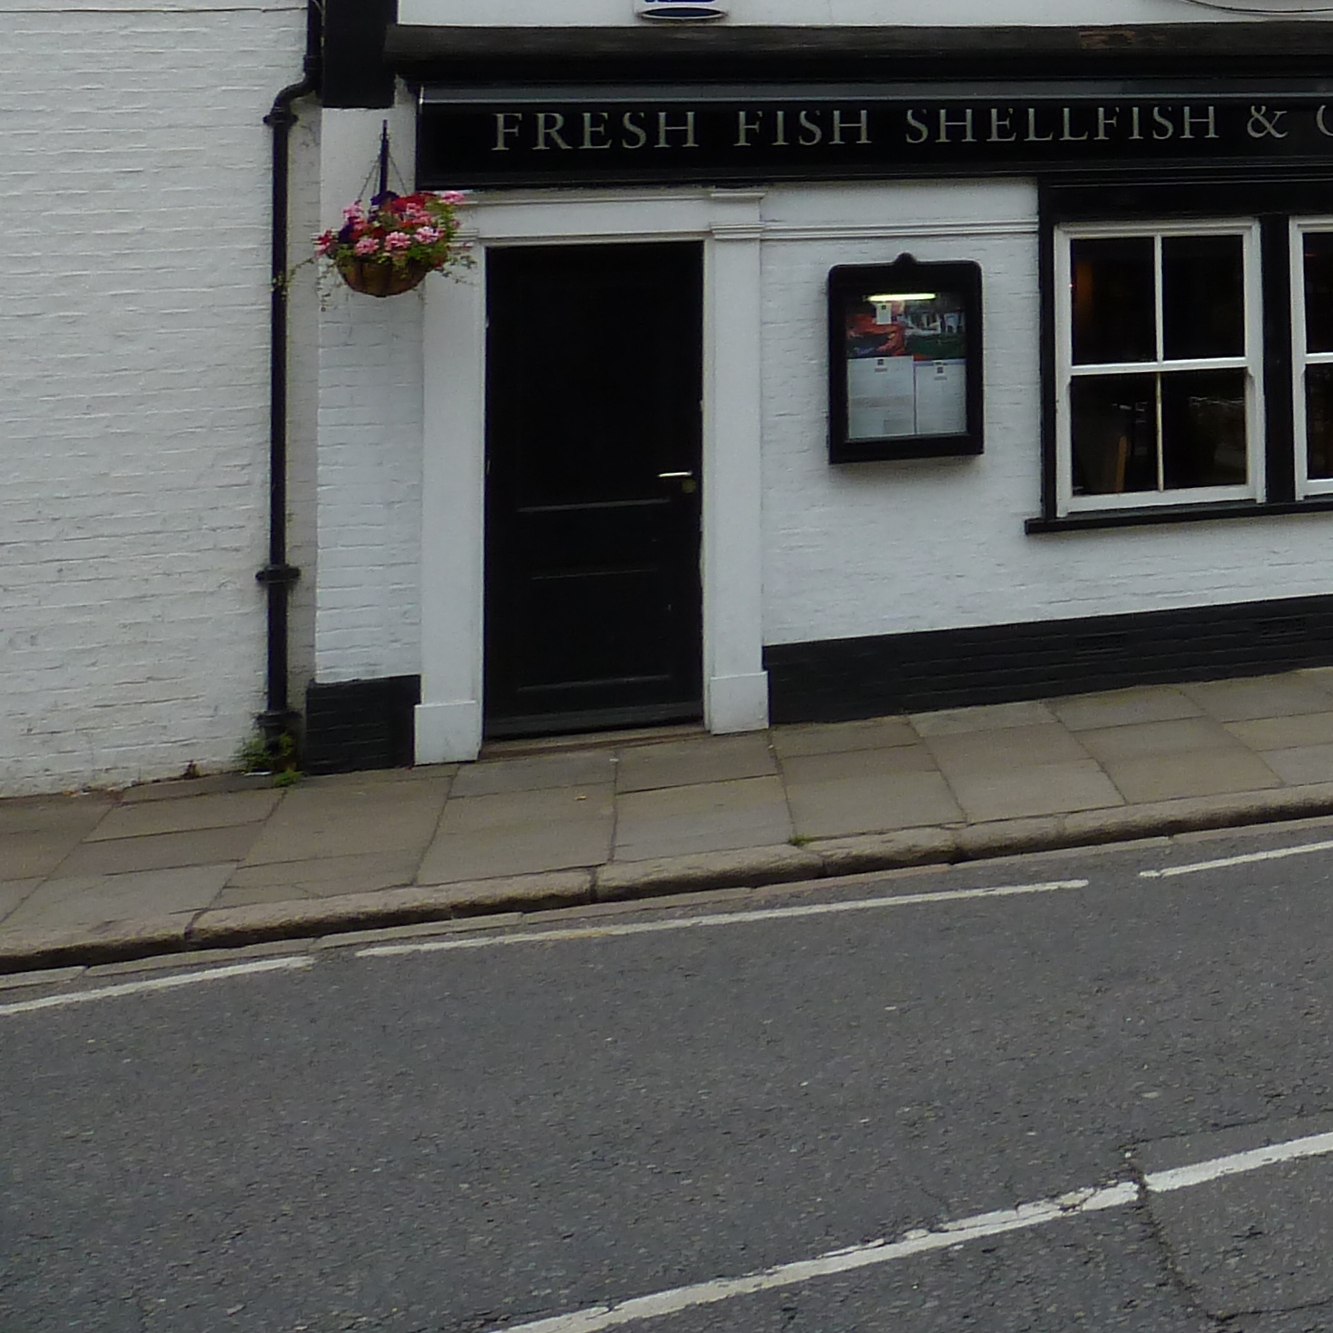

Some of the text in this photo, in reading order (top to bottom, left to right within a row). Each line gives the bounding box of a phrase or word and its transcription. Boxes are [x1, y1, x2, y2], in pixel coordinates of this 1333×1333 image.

[491, 111, 700, 151] FRESH
[733, 108, 873, 147] FISH
[905, 105, 1219, 144] SHELLFISH
[1246, 104, 1289, 139] &
